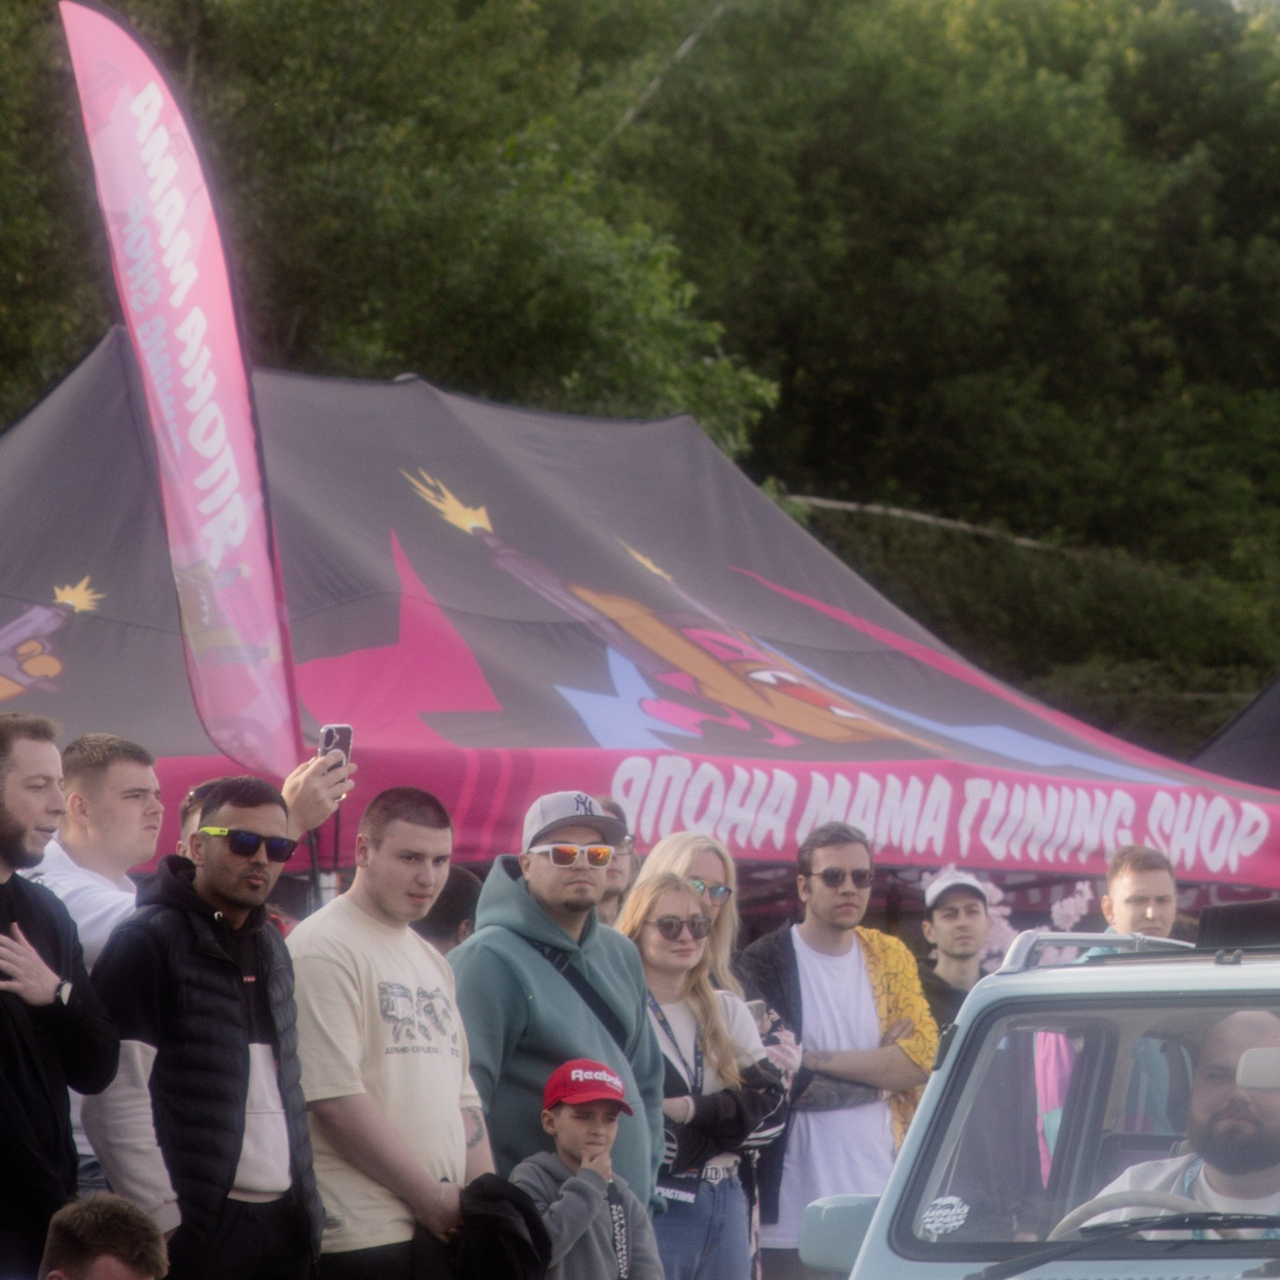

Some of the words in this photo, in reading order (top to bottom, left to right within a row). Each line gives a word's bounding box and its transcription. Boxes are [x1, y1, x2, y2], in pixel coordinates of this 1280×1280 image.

[611, 754, 798, 851] ЯПОНА
[796, 771, 952, 857] МАМА
[958, 777, 1136, 865] TUNING
[1144, 790, 1270, 875] SHOP
